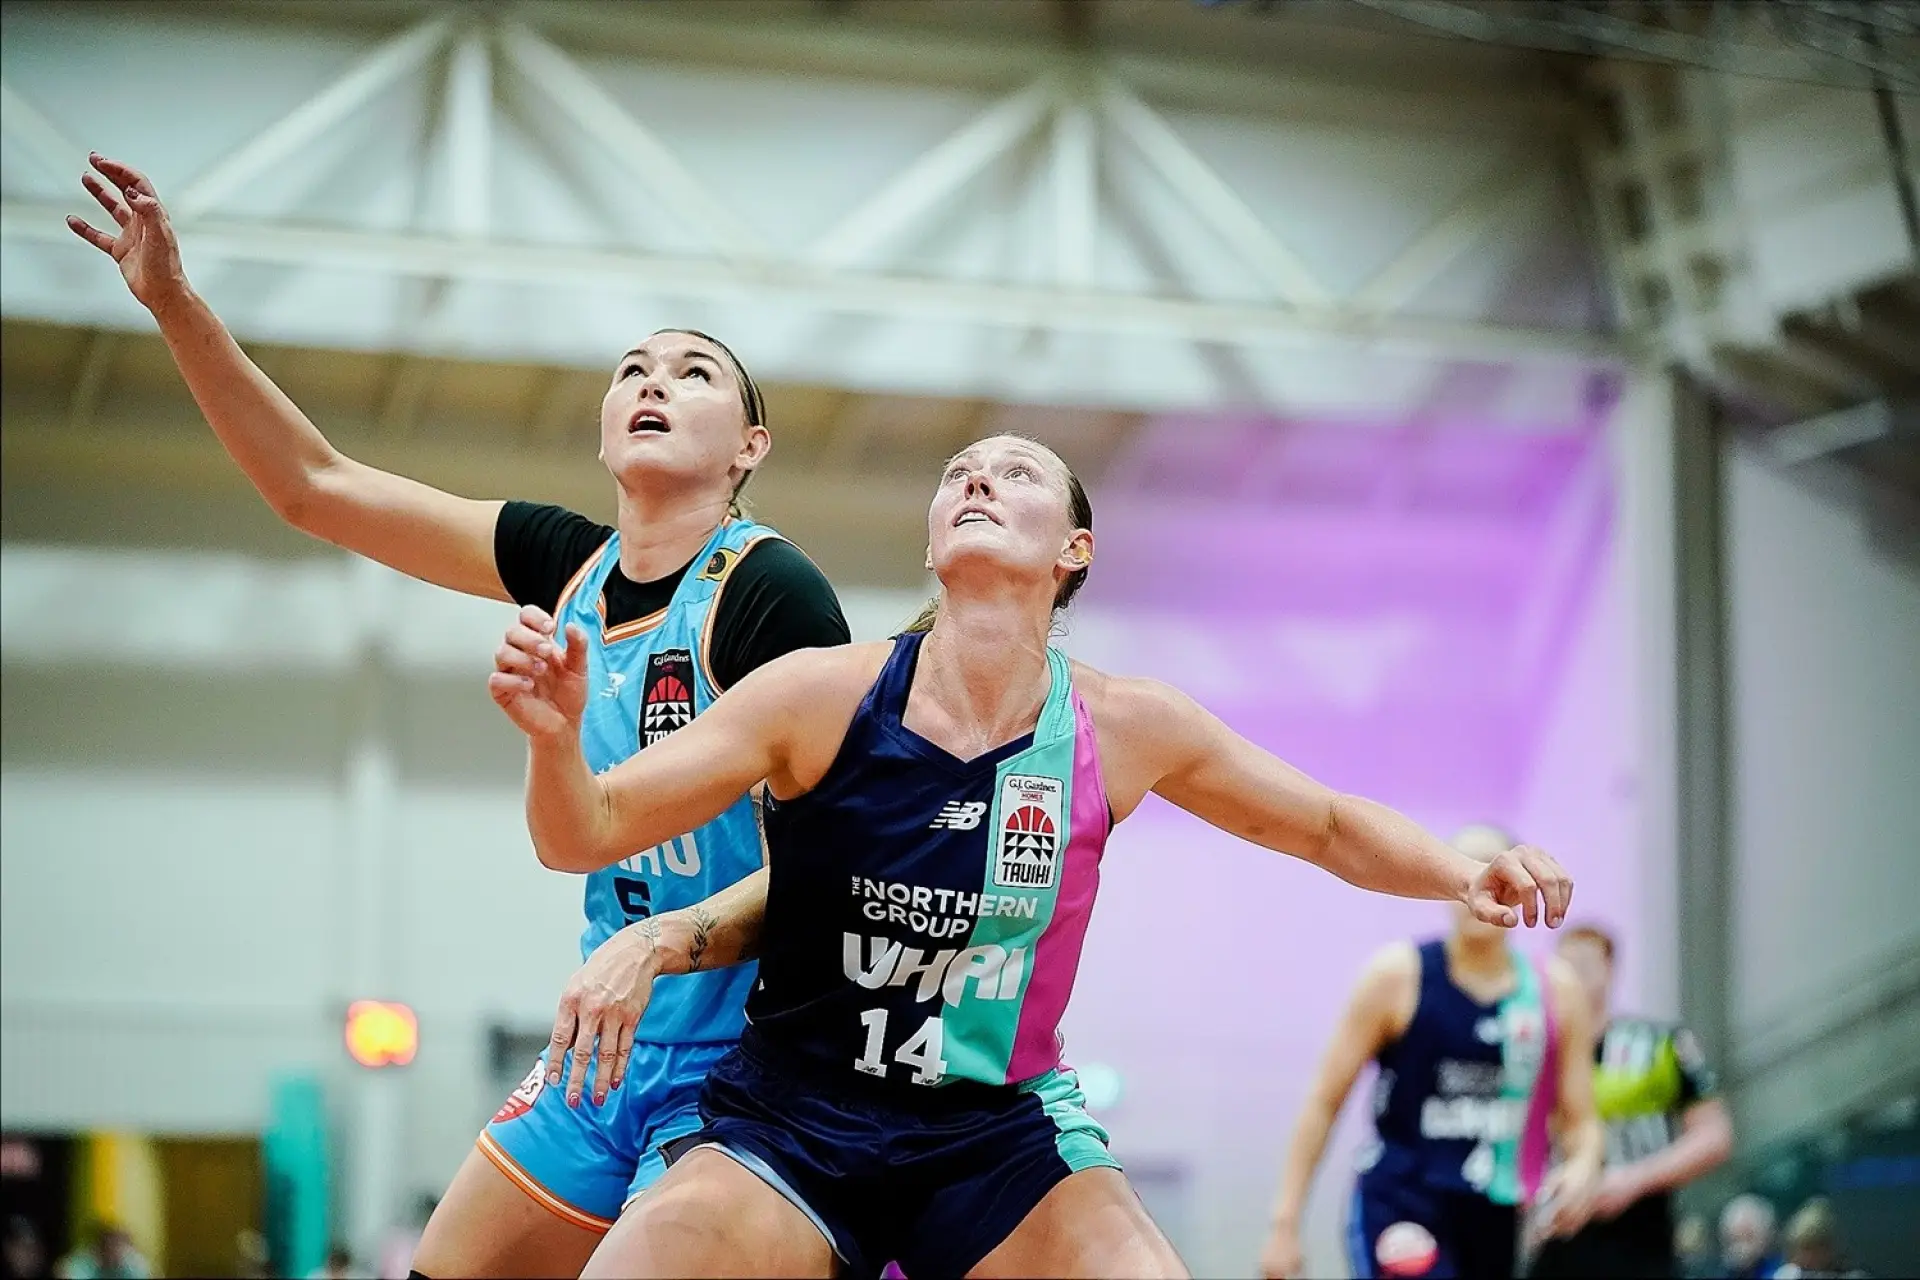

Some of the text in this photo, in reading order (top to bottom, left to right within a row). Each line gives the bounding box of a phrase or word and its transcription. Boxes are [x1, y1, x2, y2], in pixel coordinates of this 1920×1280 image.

[852, 876, 861, 896] THE
[864, 878, 1039, 919] NORTHERN
[863, 901, 970, 939] GROUP
[843, 932, 1029, 1008] WHAI
[854, 1007, 948, 1086] 14
